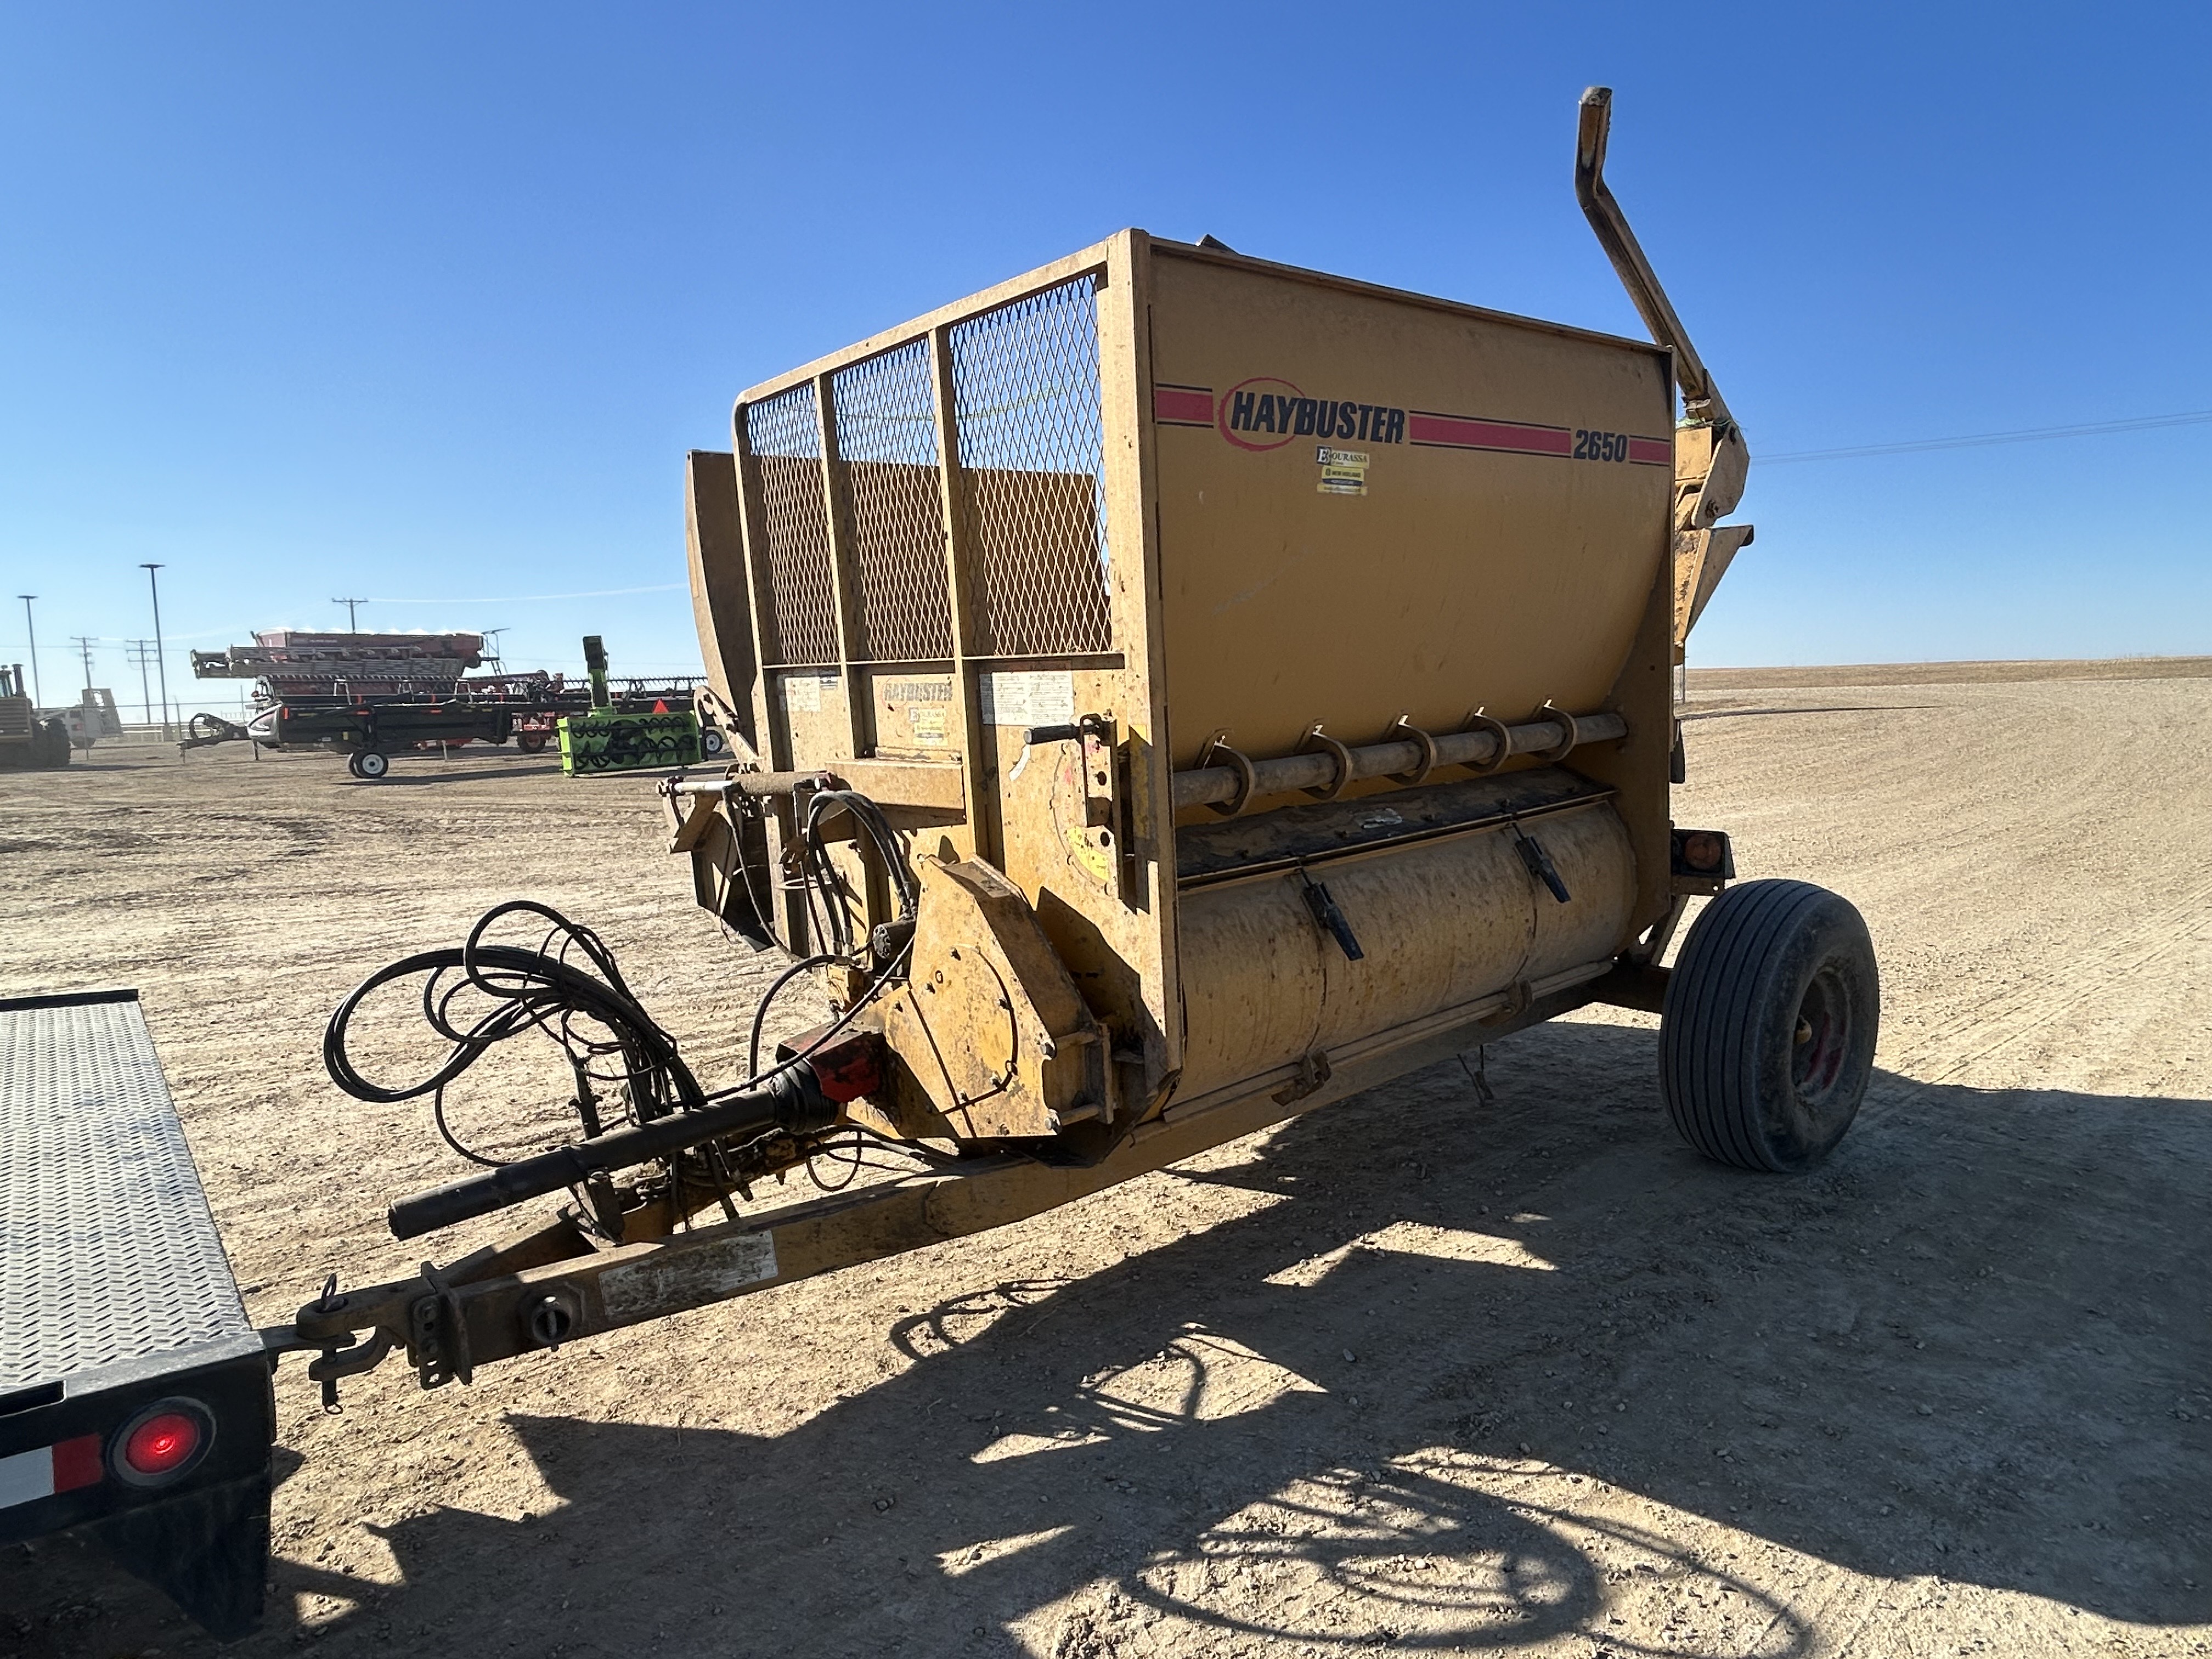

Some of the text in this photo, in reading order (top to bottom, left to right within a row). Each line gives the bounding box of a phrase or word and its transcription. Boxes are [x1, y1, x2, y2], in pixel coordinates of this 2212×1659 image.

[1231, 391, 1406, 444] HAYBUSTER
[1573, 429, 1627, 462] 2650
[884, 682, 952, 701] HAYBUSTER
